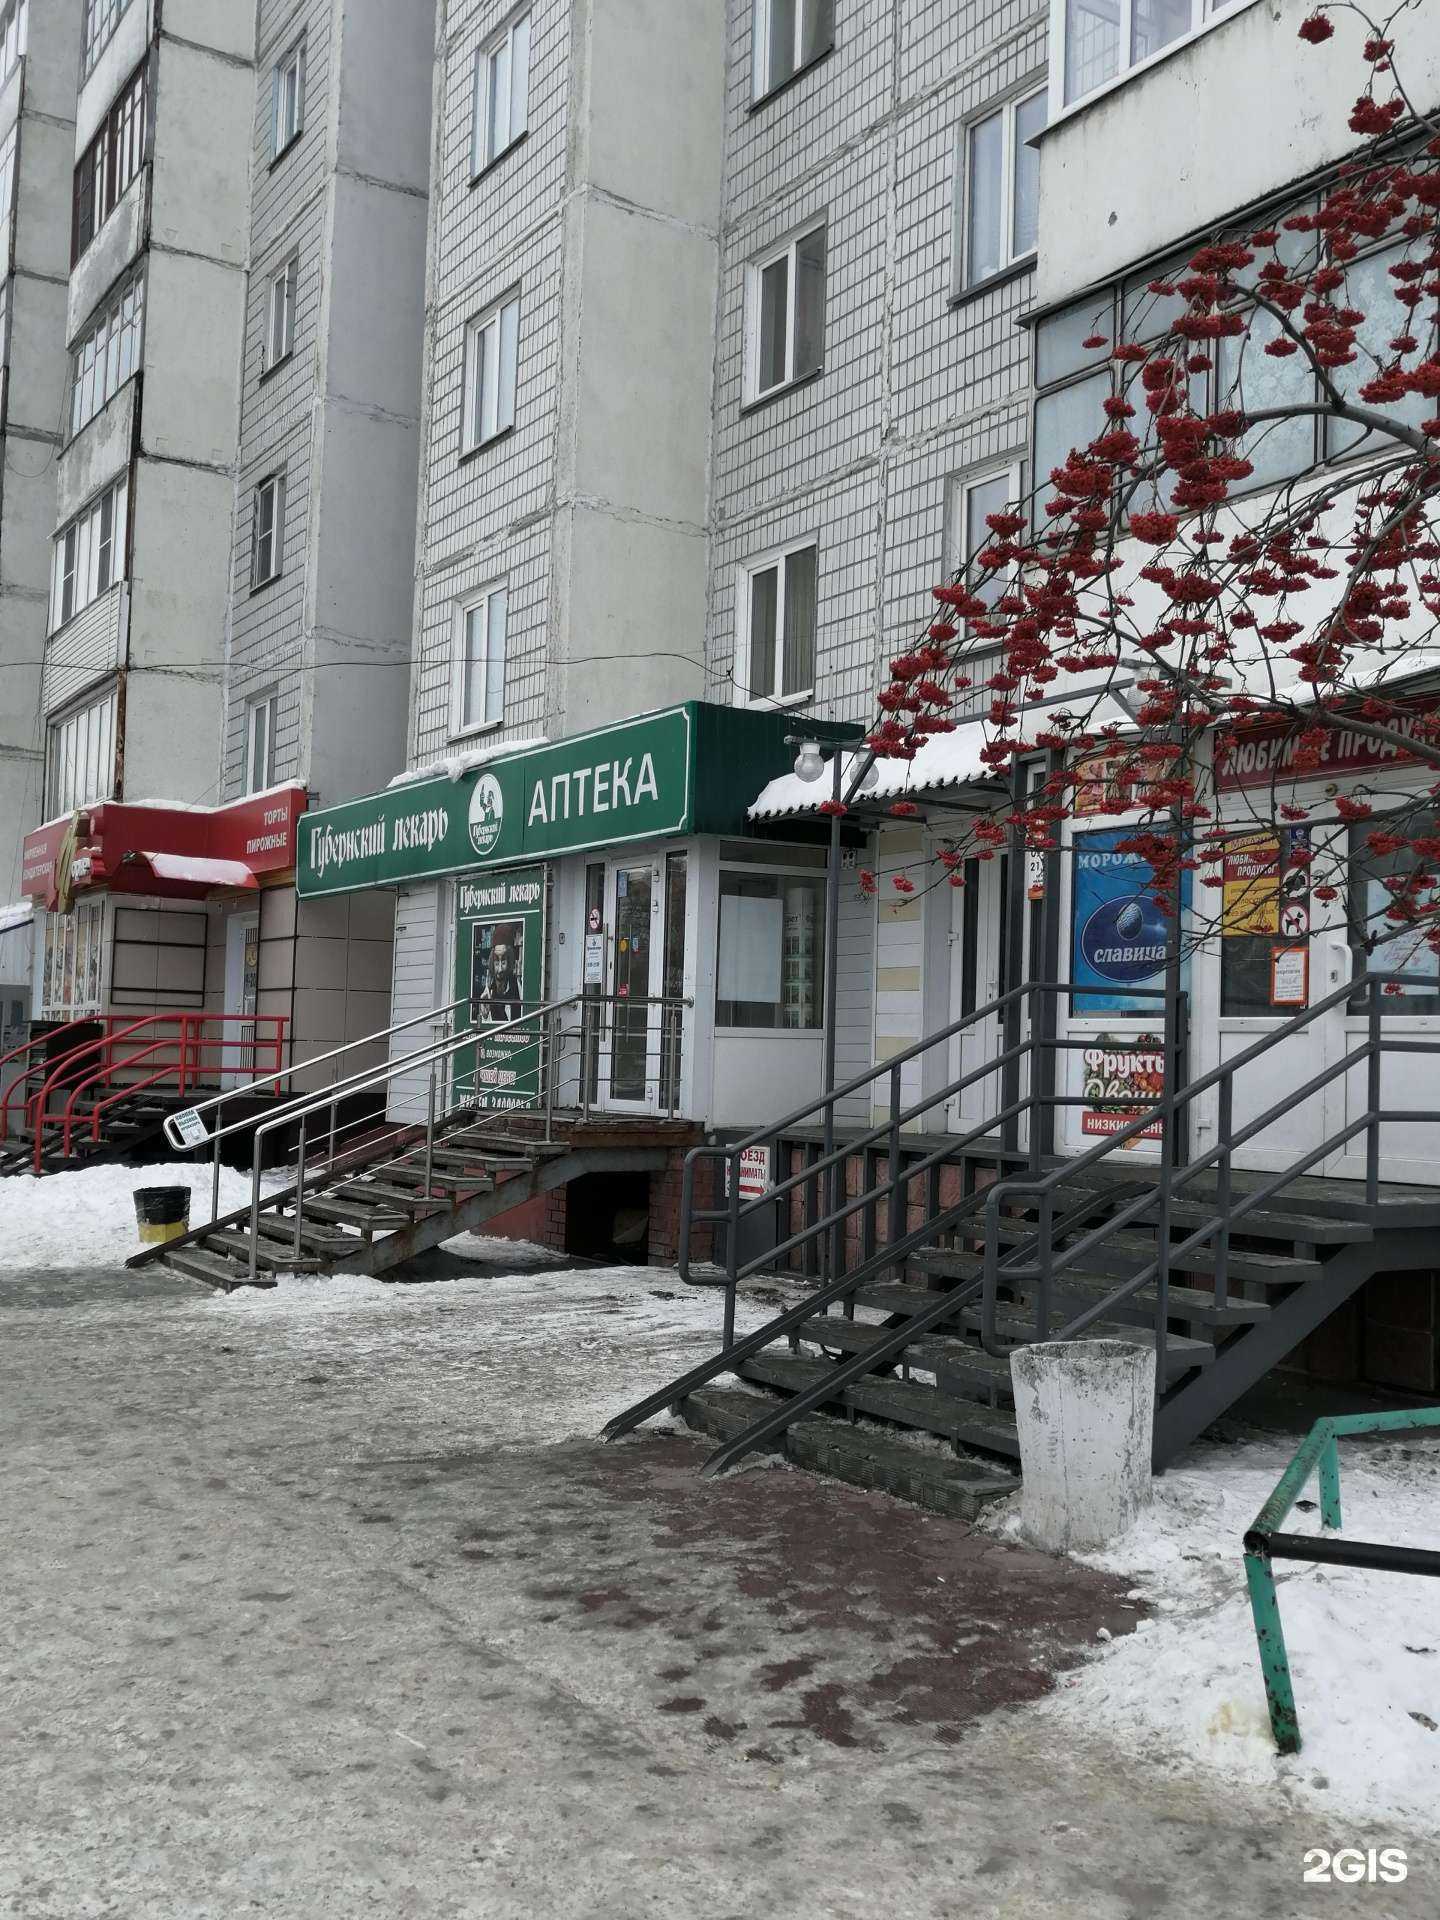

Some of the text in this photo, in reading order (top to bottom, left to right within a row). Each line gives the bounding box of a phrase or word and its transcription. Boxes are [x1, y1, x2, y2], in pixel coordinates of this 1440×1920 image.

[1222, 732, 1330, 777] ЛЮБИМЕ
[528, 753, 659, 827] АПТЕКА
[263, 807, 288, 826] ТОРТЫ
[246, 832, 287, 854] ПИРОЖНЫЕ
[310, 807, 448, 878] Губернский лекарь
[460, 882, 540, 914] Губернский лекарь
[1094, 945, 1167, 964] славица
